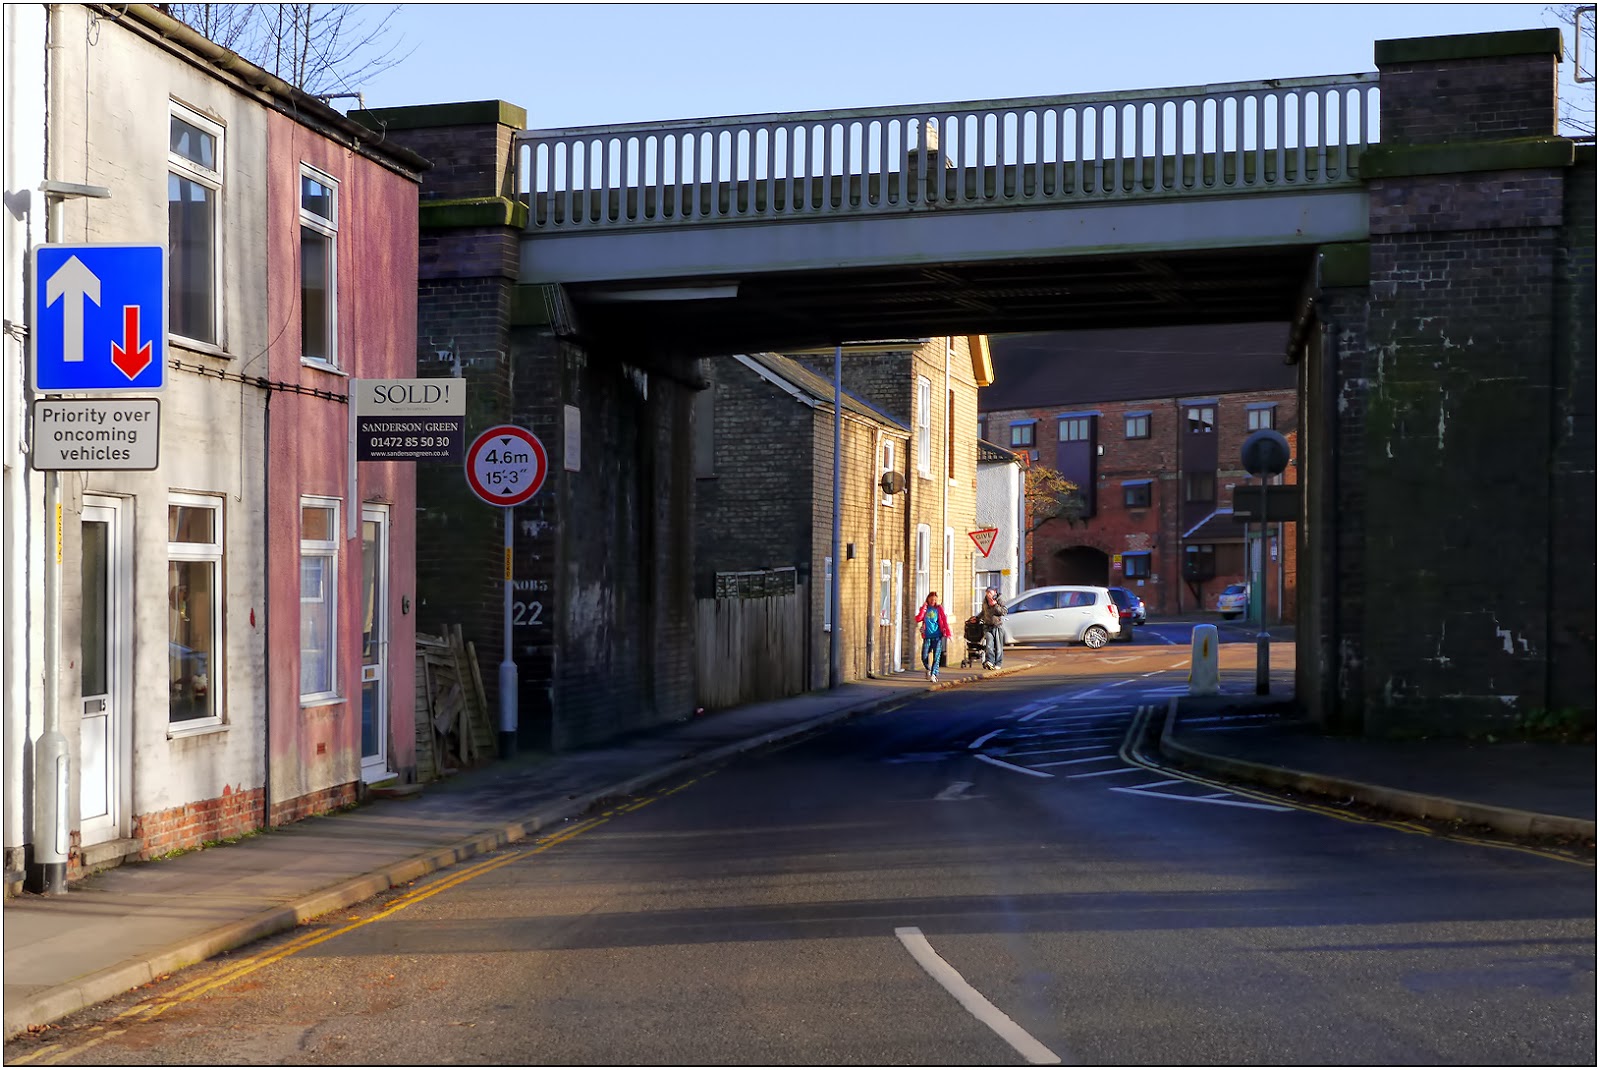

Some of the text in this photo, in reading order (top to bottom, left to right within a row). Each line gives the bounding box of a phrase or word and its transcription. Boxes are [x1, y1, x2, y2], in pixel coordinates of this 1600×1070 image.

[373, 384, 449, 404] SOLD!
[42, 408, 151, 425] Priority over
[362, 422, 459, 432] SANDERSON GREEN
[53, 427, 137, 444] oncoming
[370, 437, 450, 447] 01472 85 50 30
[60, 446, 130, 460] vehicles
[370, 450, 450, 458] www.sandersongreen.co.uk
[484, 449, 528, 464] 4.6m
[975, 532, 993, 540] GIVE
[513, 601, 543, 626] 22
